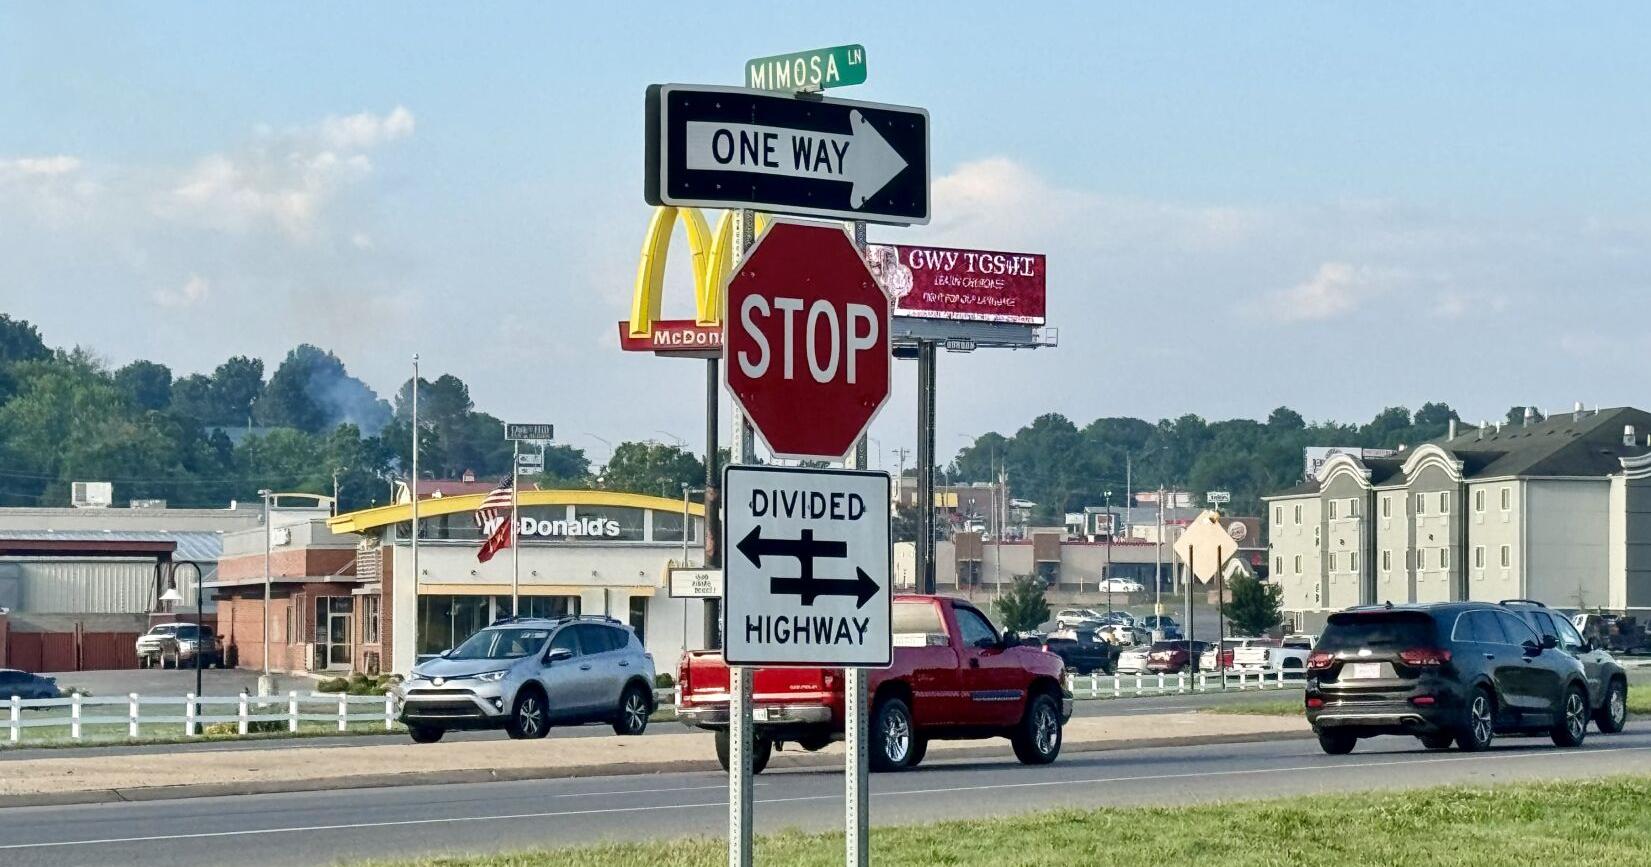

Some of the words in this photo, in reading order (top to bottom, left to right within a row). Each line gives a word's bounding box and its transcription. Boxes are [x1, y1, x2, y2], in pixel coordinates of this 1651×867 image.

[751, 54, 840, 90] MIMOSA
[848, 48, 862, 65] LN
[712, 128, 780, 168] ONE
[791, 135, 850, 175] WAY
[653, 330, 724, 345] McDon
[738, 293, 879, 384] STOP
[752, 489, 865, 521] DIVIDED
[483, 516, 620, 537] MDonald's
[745, 615, 870, 645] HIGHWAY
